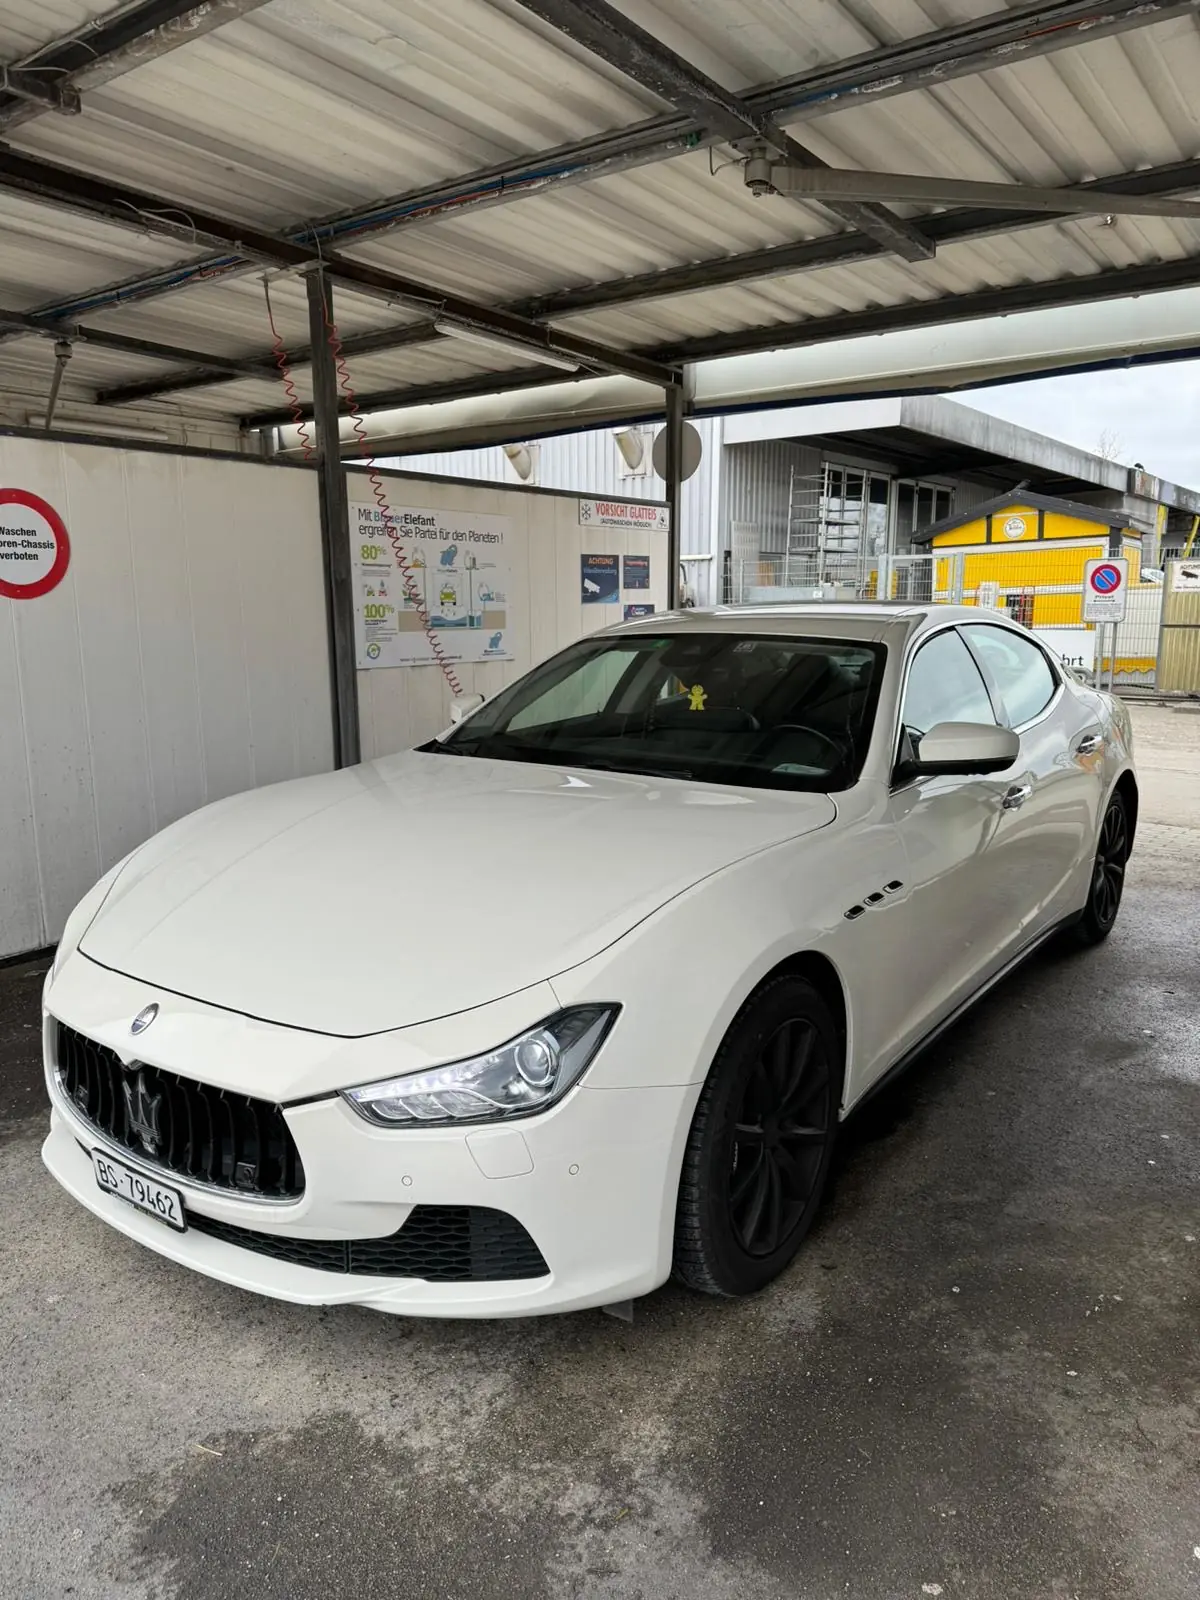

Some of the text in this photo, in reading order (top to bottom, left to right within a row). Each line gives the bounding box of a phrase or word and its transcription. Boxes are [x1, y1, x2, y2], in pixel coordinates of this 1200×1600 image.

[358, 508, 435, 526] Mit BlerElefant
[595, 502, 657, 521] VORSICHT GLATTEIS
[400, 525, 413, 538] Sie
[414, 526, 437, 540] Partei
[439, 528, 450, 541] für
[452, 530, 467, 542] den
[468, 530, 500, 543] Planeten
[0, 551, 39, 560] verboten
[588, 557, 614, 565] ACHTUNG
